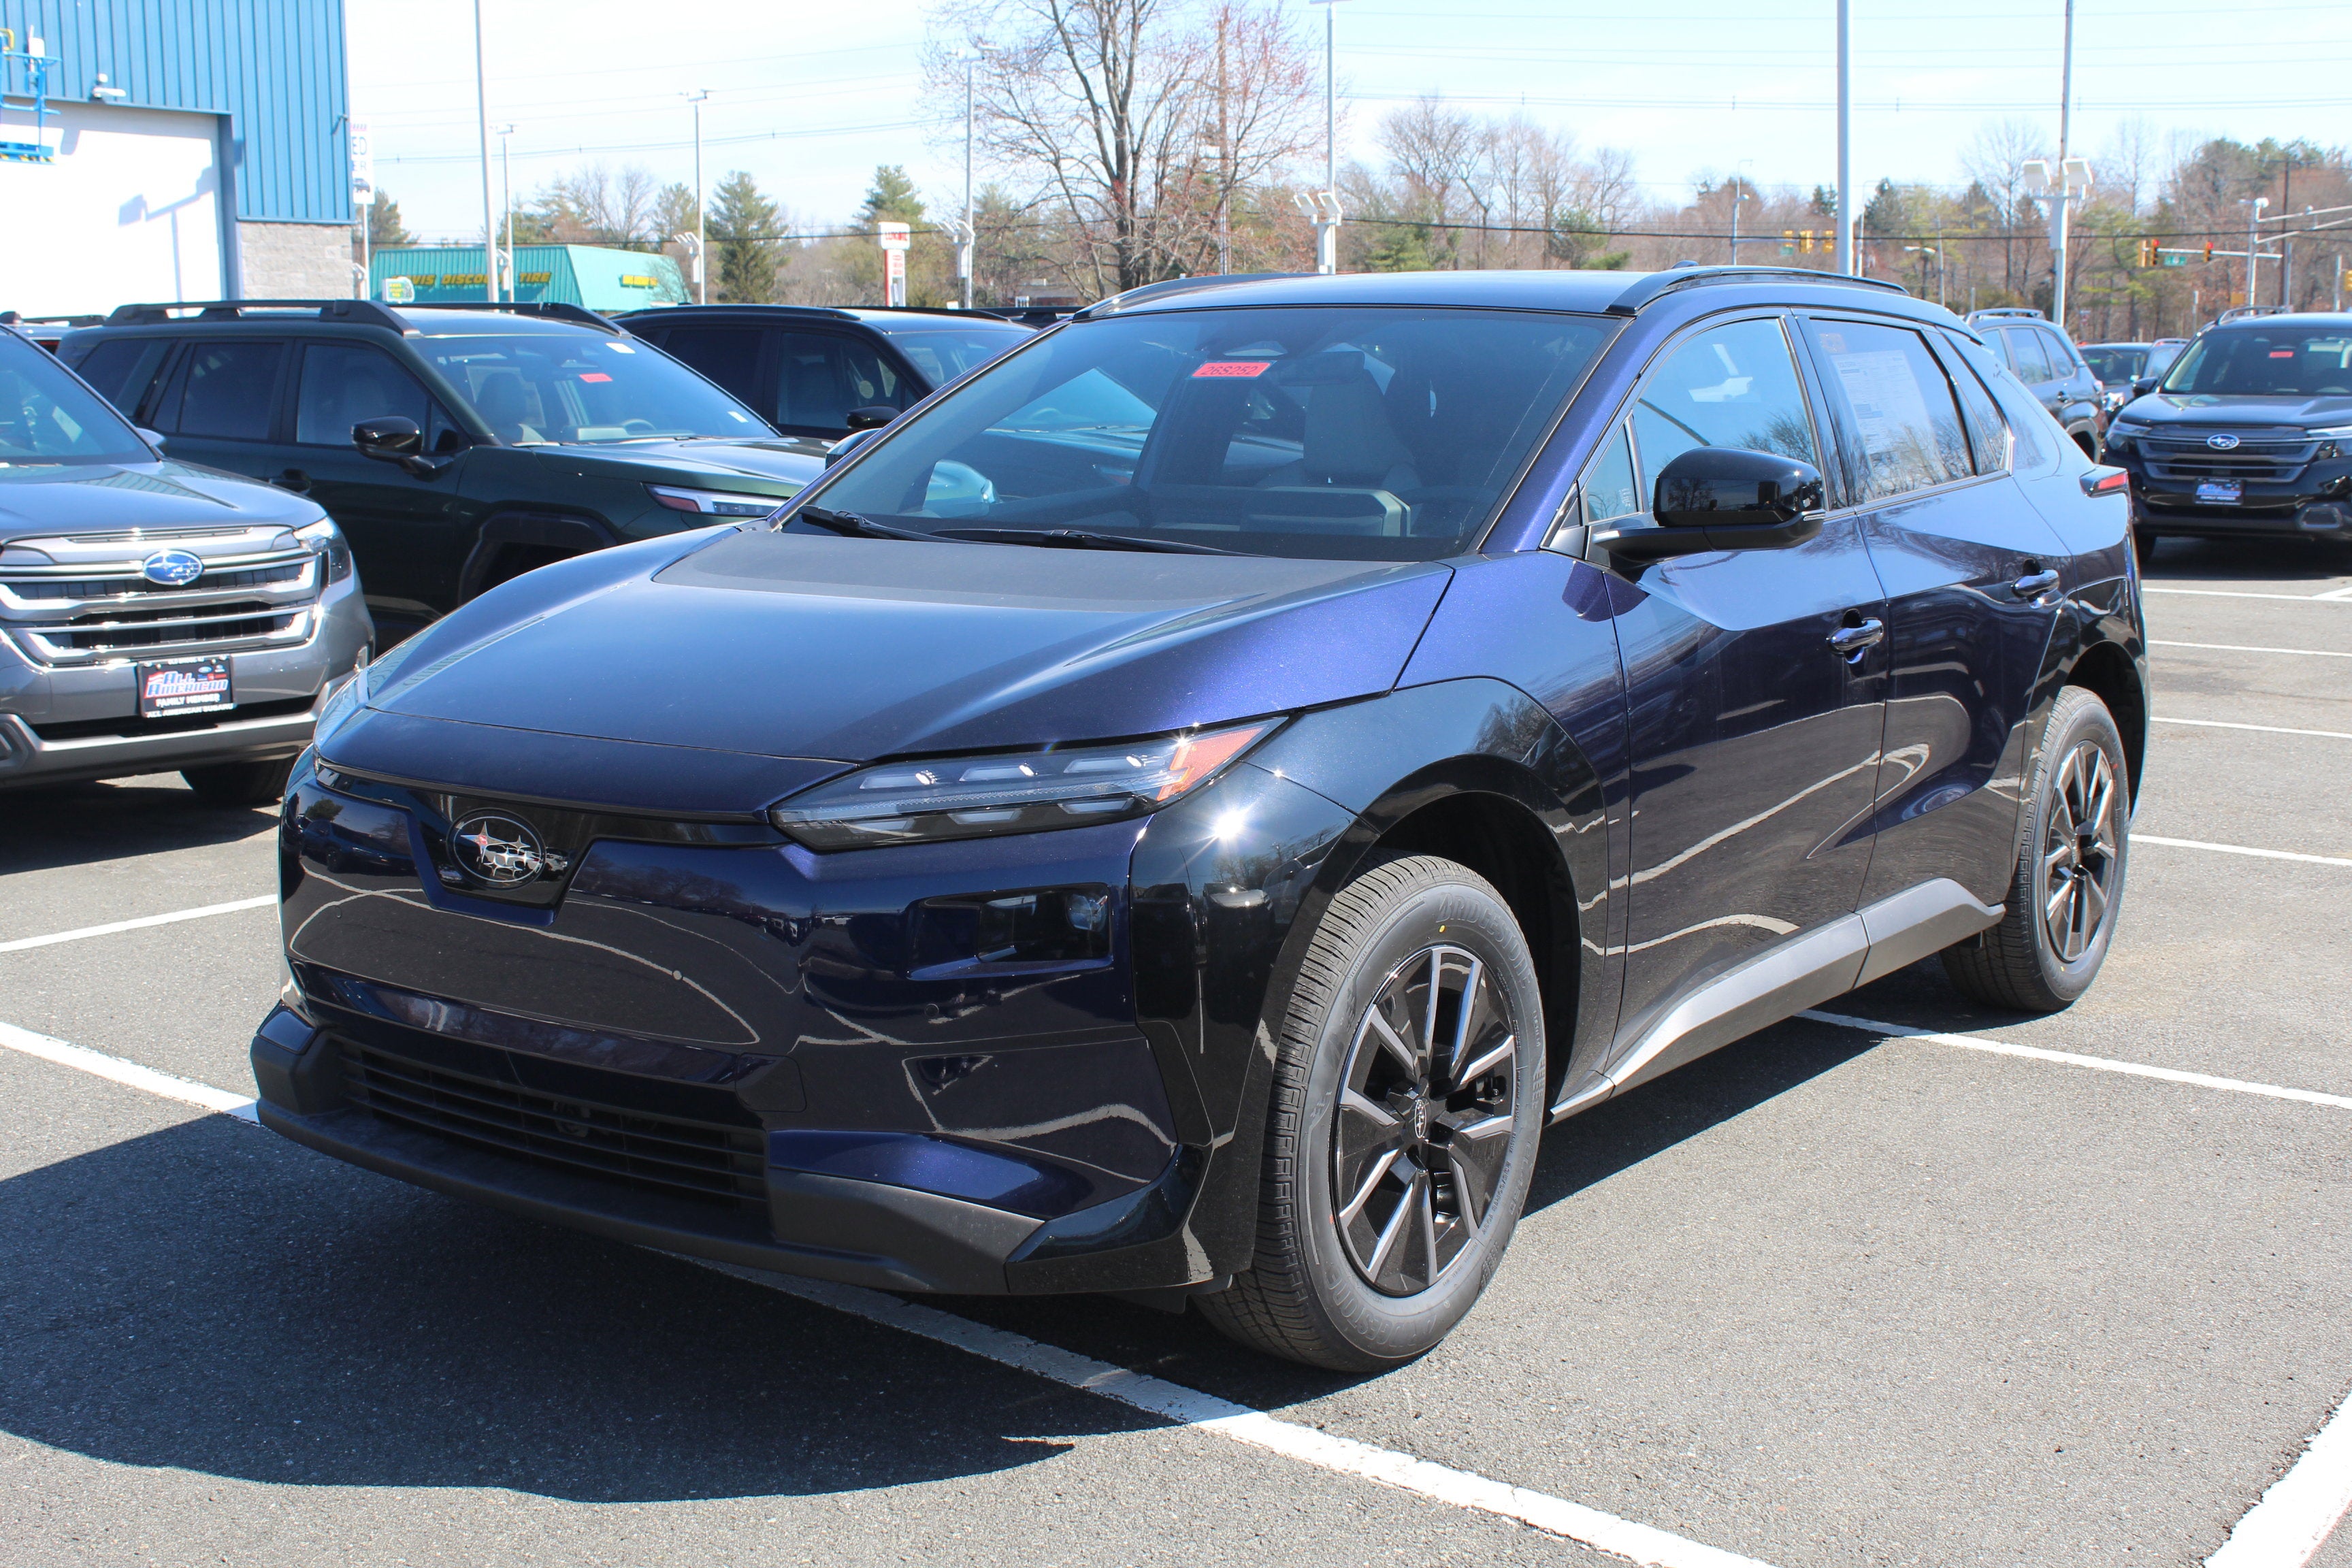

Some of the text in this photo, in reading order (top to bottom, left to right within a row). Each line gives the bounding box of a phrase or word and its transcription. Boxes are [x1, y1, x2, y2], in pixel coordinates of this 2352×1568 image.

[519, 272, 551, 282] TIRE
[1200, 365, 1259, 375] 26S252
[156, 693, 220, 707] FAMILY MEMBER
[163, 706, 202, 717] AMERICAN
[203, 702, 233, 712] SUBARU
[1435, 892, 1534, 988] BRIDGESTONE
